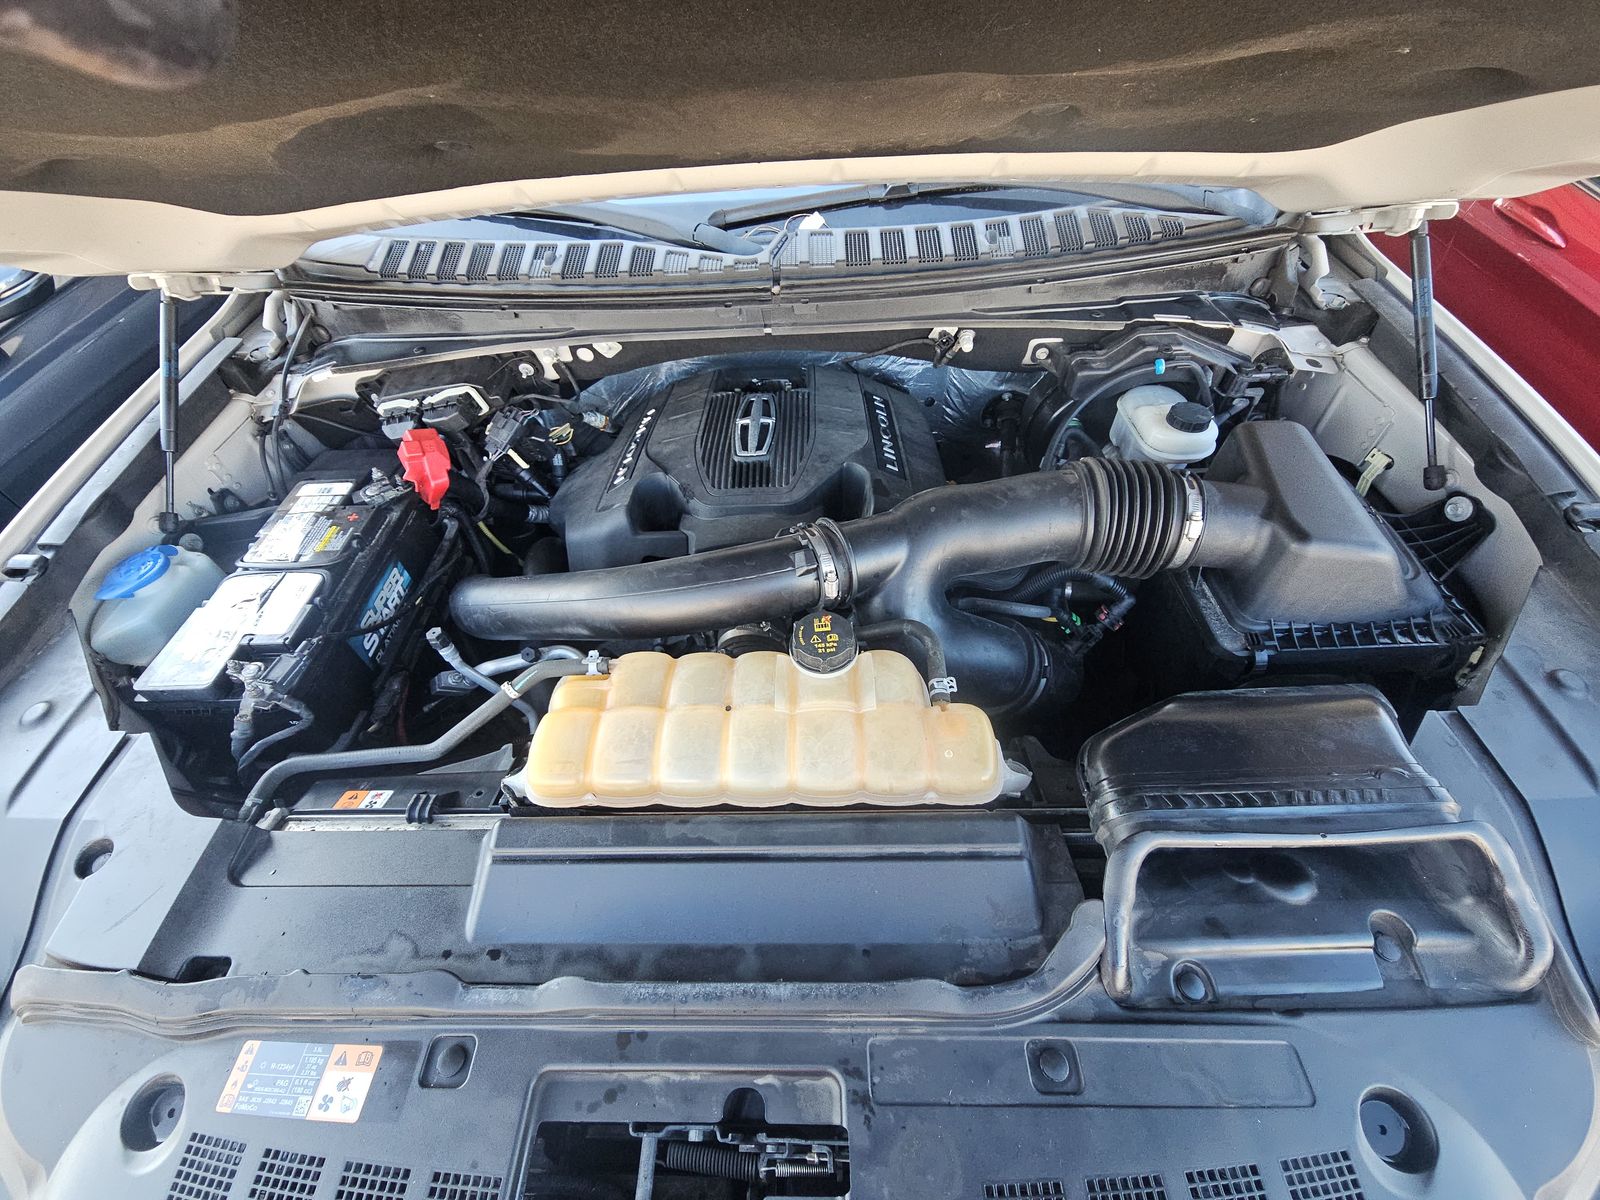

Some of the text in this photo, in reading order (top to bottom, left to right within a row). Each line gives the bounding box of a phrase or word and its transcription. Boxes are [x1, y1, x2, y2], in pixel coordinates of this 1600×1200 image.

[872, 395, 899, 472] LINCOLN
[360, 567, 402, 630] SUPER
[375, 619, 401, 664] PLATIN
